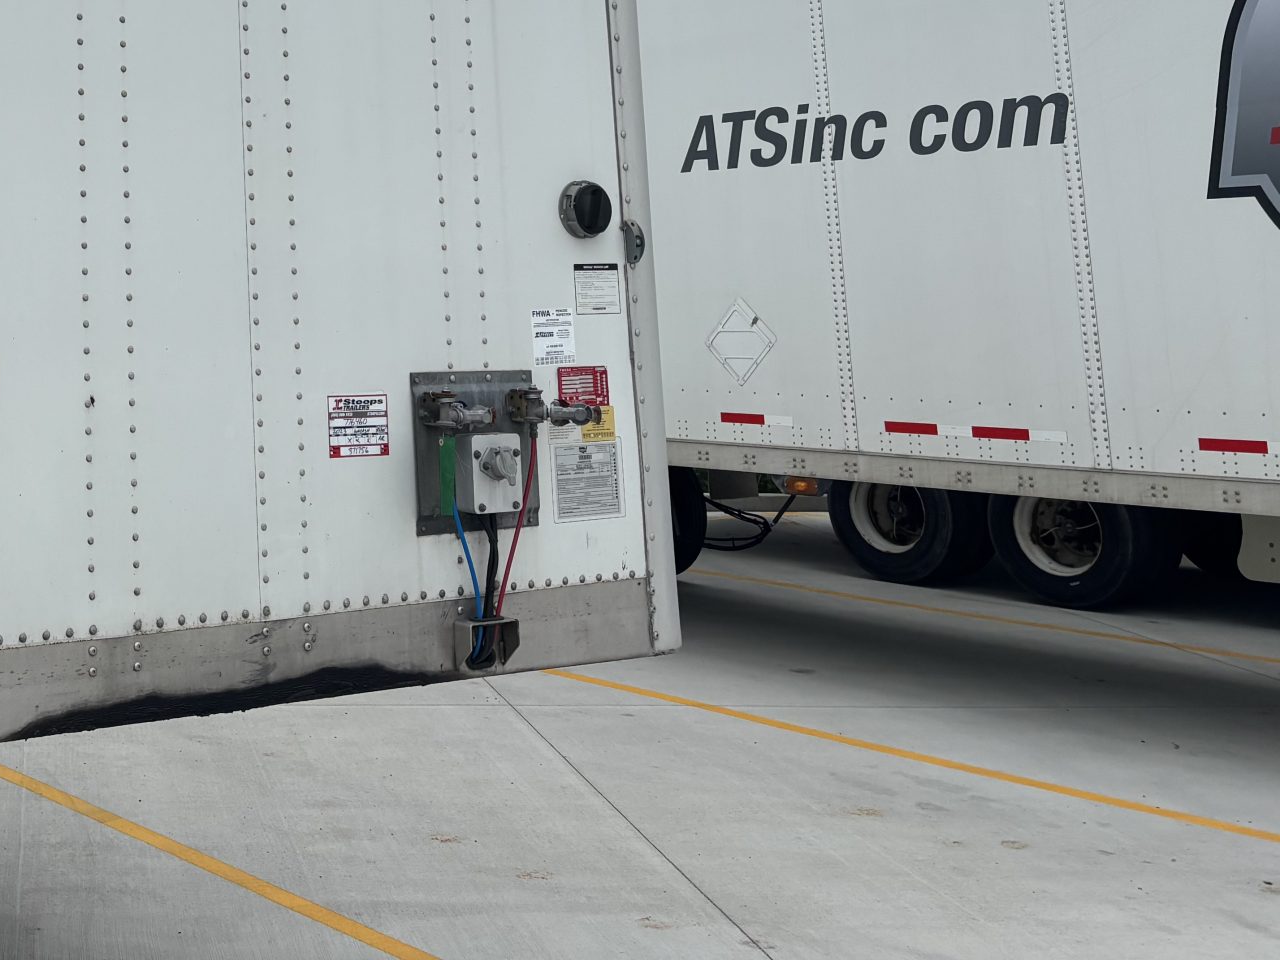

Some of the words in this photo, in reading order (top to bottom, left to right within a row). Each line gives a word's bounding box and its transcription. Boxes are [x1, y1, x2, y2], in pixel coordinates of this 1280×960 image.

[680, 103, 888, 173] ATSinc
[908, 91, 1071, 156] com
[531, 310, 551, 318] FHWA
[342, 398, 384, 406] Stoops
